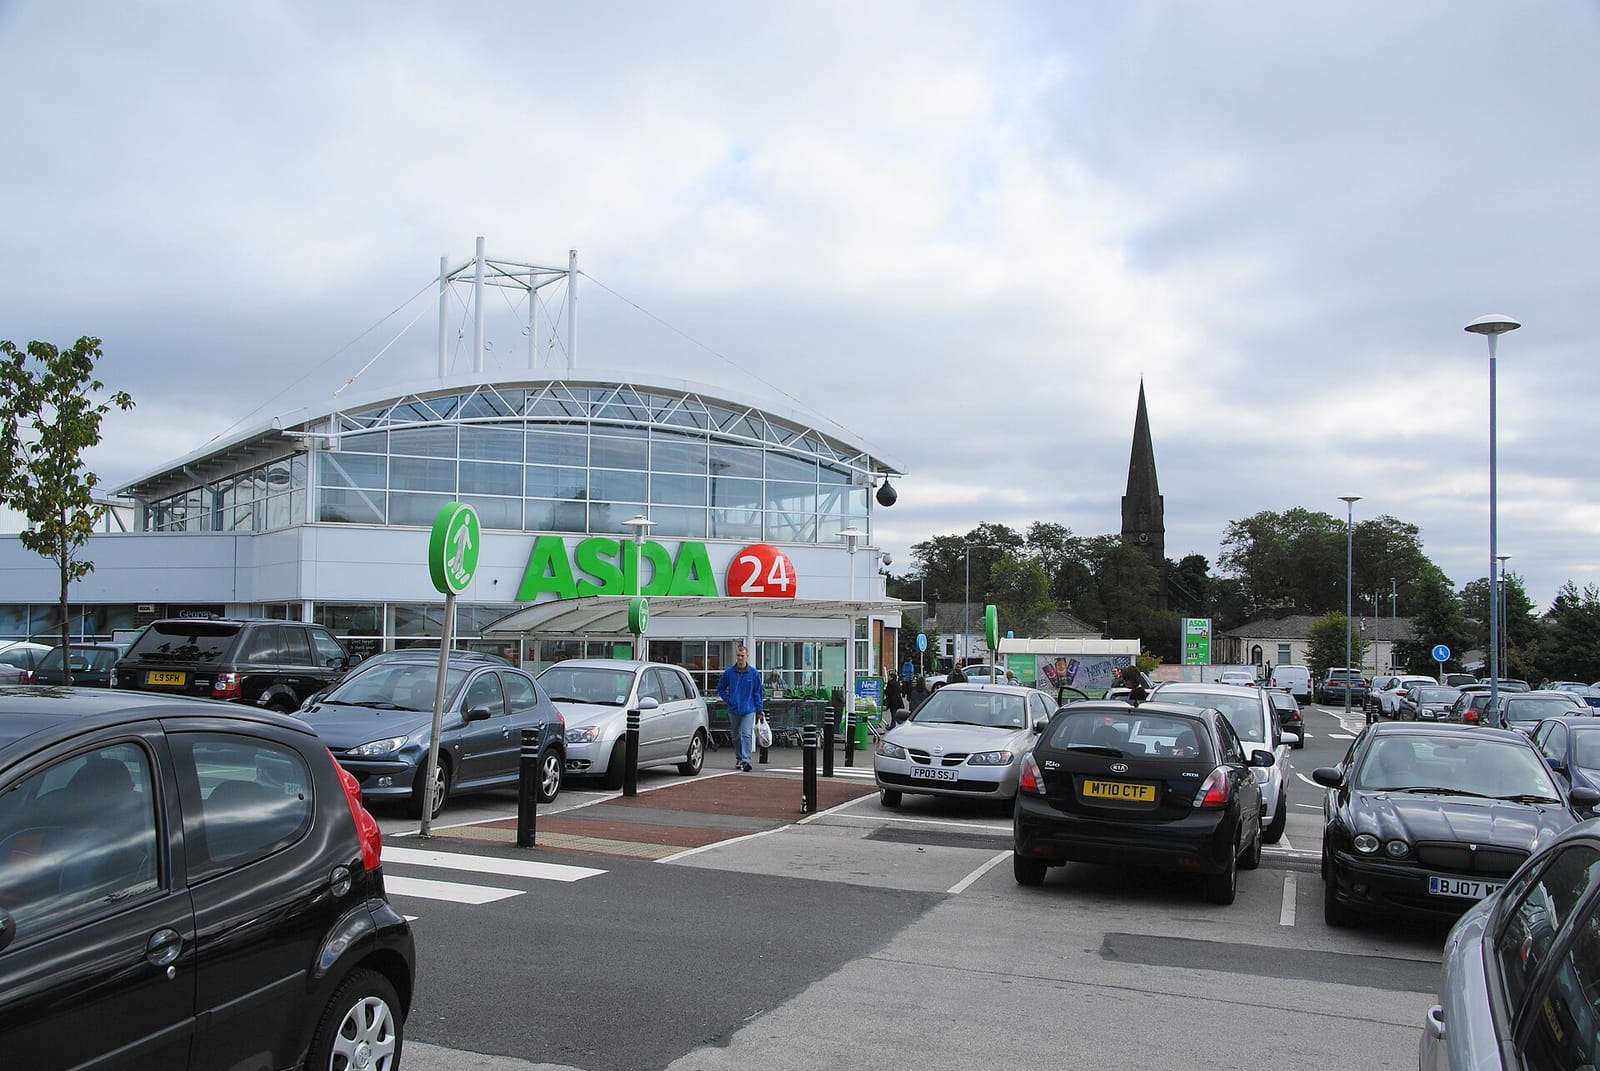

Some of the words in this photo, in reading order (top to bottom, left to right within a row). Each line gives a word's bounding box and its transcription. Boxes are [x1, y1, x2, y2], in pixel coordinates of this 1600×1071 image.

[515, 535, 719, 601] ASDA
[739, 554, 790, 593] 24
[154, 673, 164, 682] L9
[165, 674, 180, 682] SFH
[1045, 760, 1060, 768] Rio
[914, 769, 936, 779] FP03
[938, 771, 955, 780] SSJ
[1091, 783, 1120, 795] MT10
[1123, 785, 1148, 798] CTF
[1440, 880, 1480, 896] BJ07
